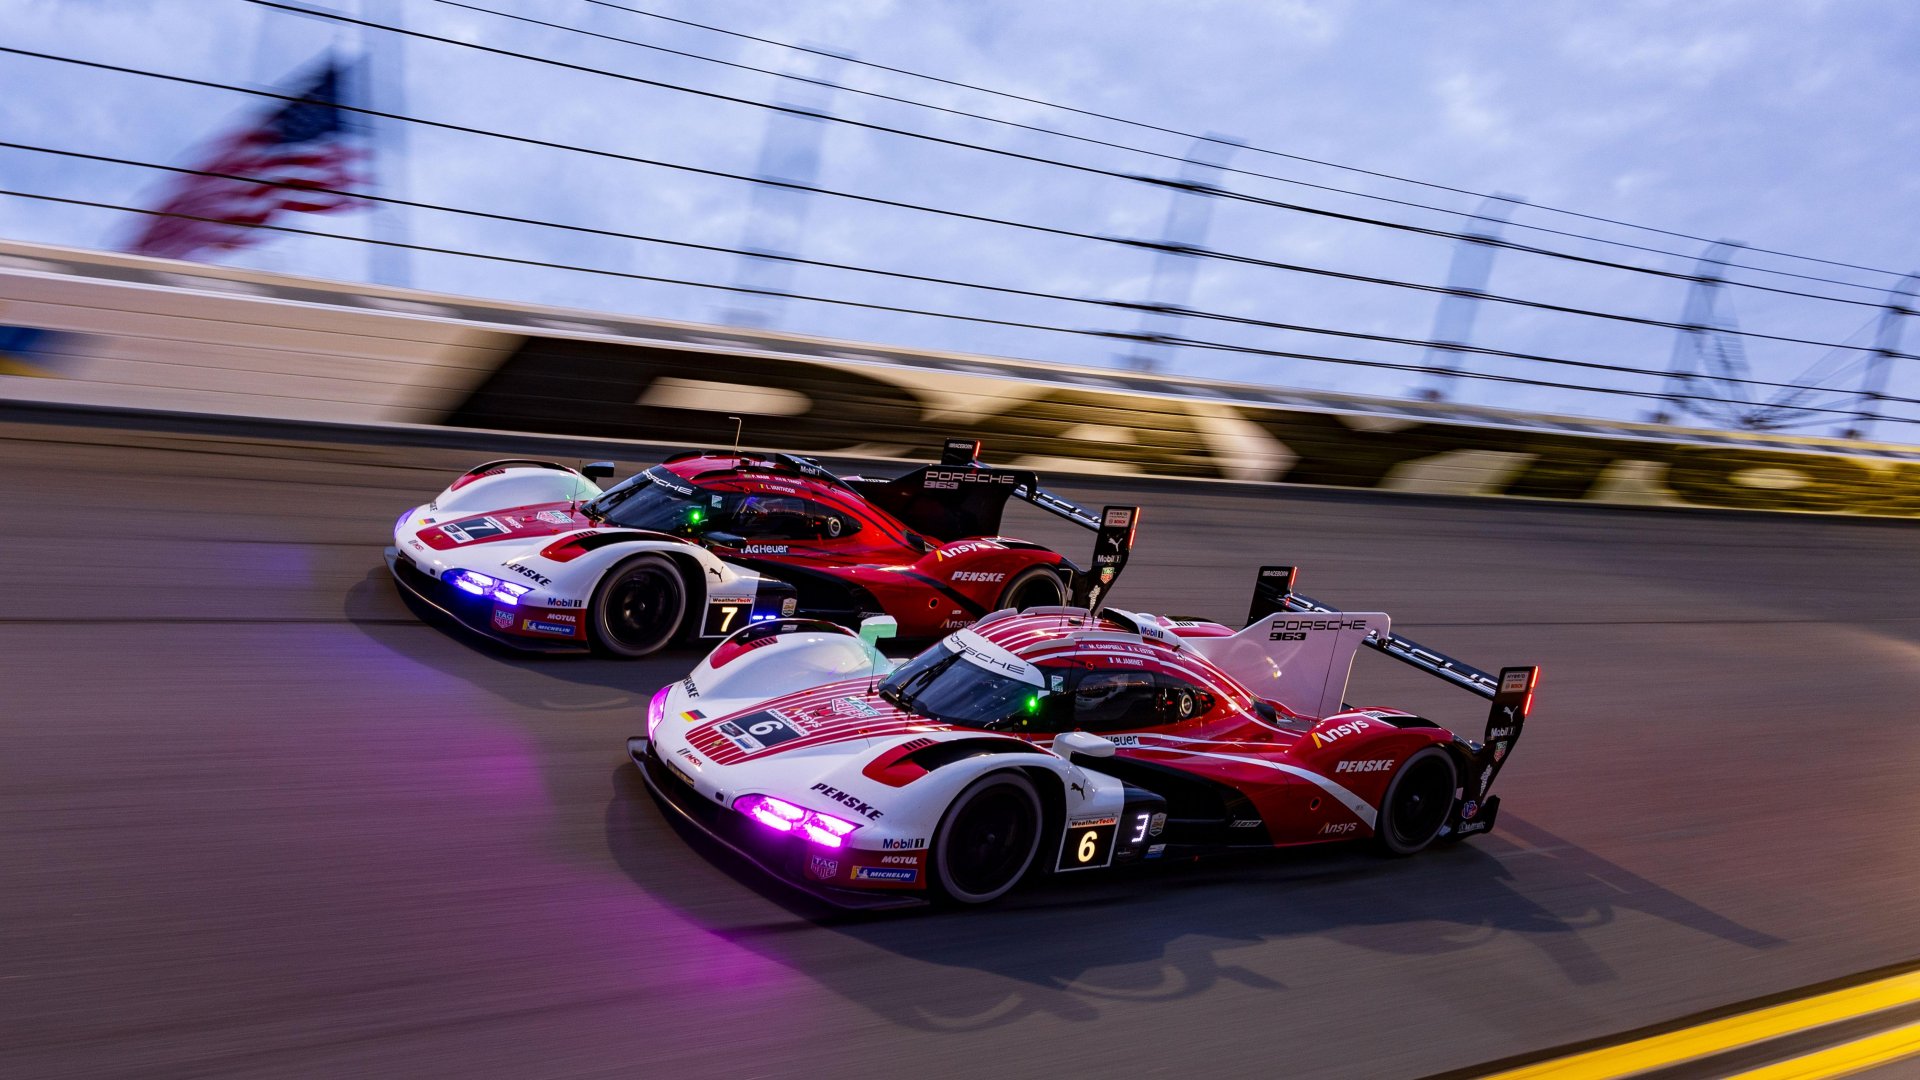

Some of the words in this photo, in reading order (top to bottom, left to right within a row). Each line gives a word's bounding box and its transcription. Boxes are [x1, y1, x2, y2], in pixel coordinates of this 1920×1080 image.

[800, 466, 815, 475] Mobil
[925, 471, 1014, 484] PORSCHE
[924, 481, 958, 490] 963
[463, 521, 496, 531] 7
[1097, 555, 1113, 563] Mobil
[951, 571, 1005, 582] PENSKE
[547, 597, 572, 607] Mobil
[496, 611, 513, 620] TAG
[547, 613, 576, 623] MOTUL
[720, 606, 739, 633] 7
[537, 625, 571, 633] MICHELIN
[1271, 620, 1366, 631] PORSCHE
[1141, 626, 1157, 637] Mobil
[1268, 632, 1307, 641] 963
[749, 720, 784, 735] 6
[1491, 727, 1507, 737] Mobil
[1311, 718, 1370, 749] Ansys
[1335, 759, 1395, 773] PENSKE
[810, 783, 884, 821] PENSKE
[1071, 818, 1116, 827] WeatherTech
[1131, 813, 1149, 843] 3
[1318, 822, 1357, 835] Ansys
[882, 838, 913, 849] Mobil
[914, 838, 925, 848] 1
[1077, 830, 1098, 863] 6
[814, 857, 836, 868] TAG
[881, 856, 918, 865] MOTUL
[869, 871, 911, 879] MICHELIN
